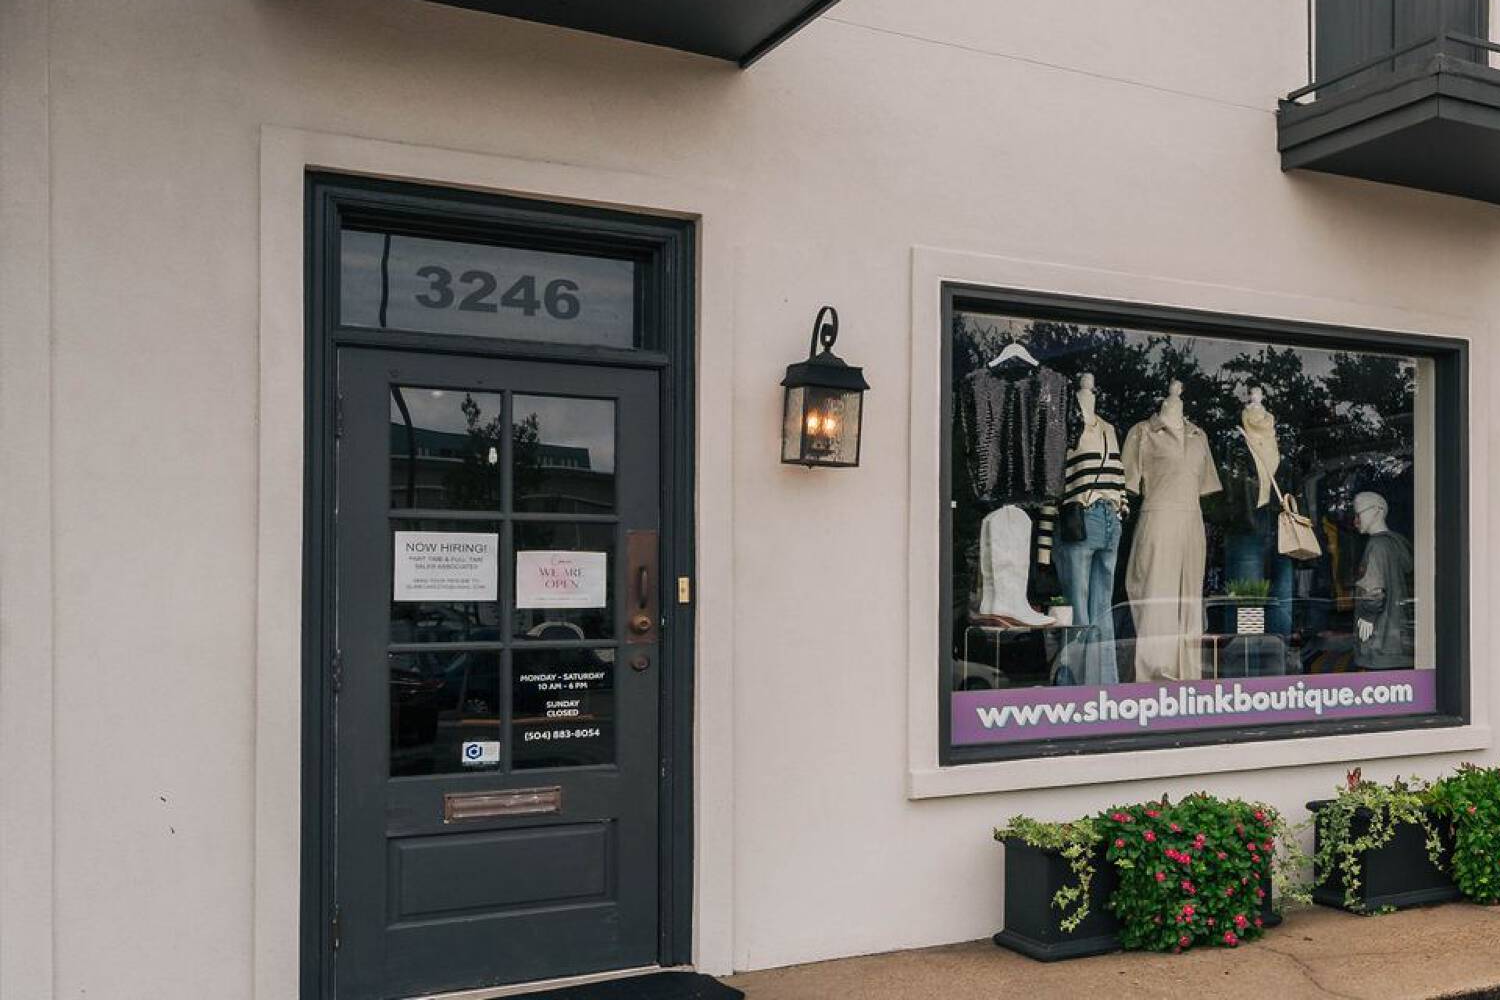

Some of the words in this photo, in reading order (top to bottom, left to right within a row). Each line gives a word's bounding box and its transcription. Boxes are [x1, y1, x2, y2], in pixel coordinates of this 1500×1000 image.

[415, 265, 581, 320] 3246
[405, 543, 438, 553] NOW
[440, 543, 488, 554] HIRING!
[519, 673, 557, 682] MONDAY
[563, 671, 605, 681] SATURDAY
[538, 682, 548, 690] 10
[549, 682, 562, 690] AM
[568, 682, 574, 690] 6
[575, 681, 588, 689] PM
[546, 700, 581, 709] SUNDAY
[976, 682, 1413, 729] www.shopblinkboutique.com
[546, 708, 579, 718] CLOSED
[524, 730, 551, 742] (504)
